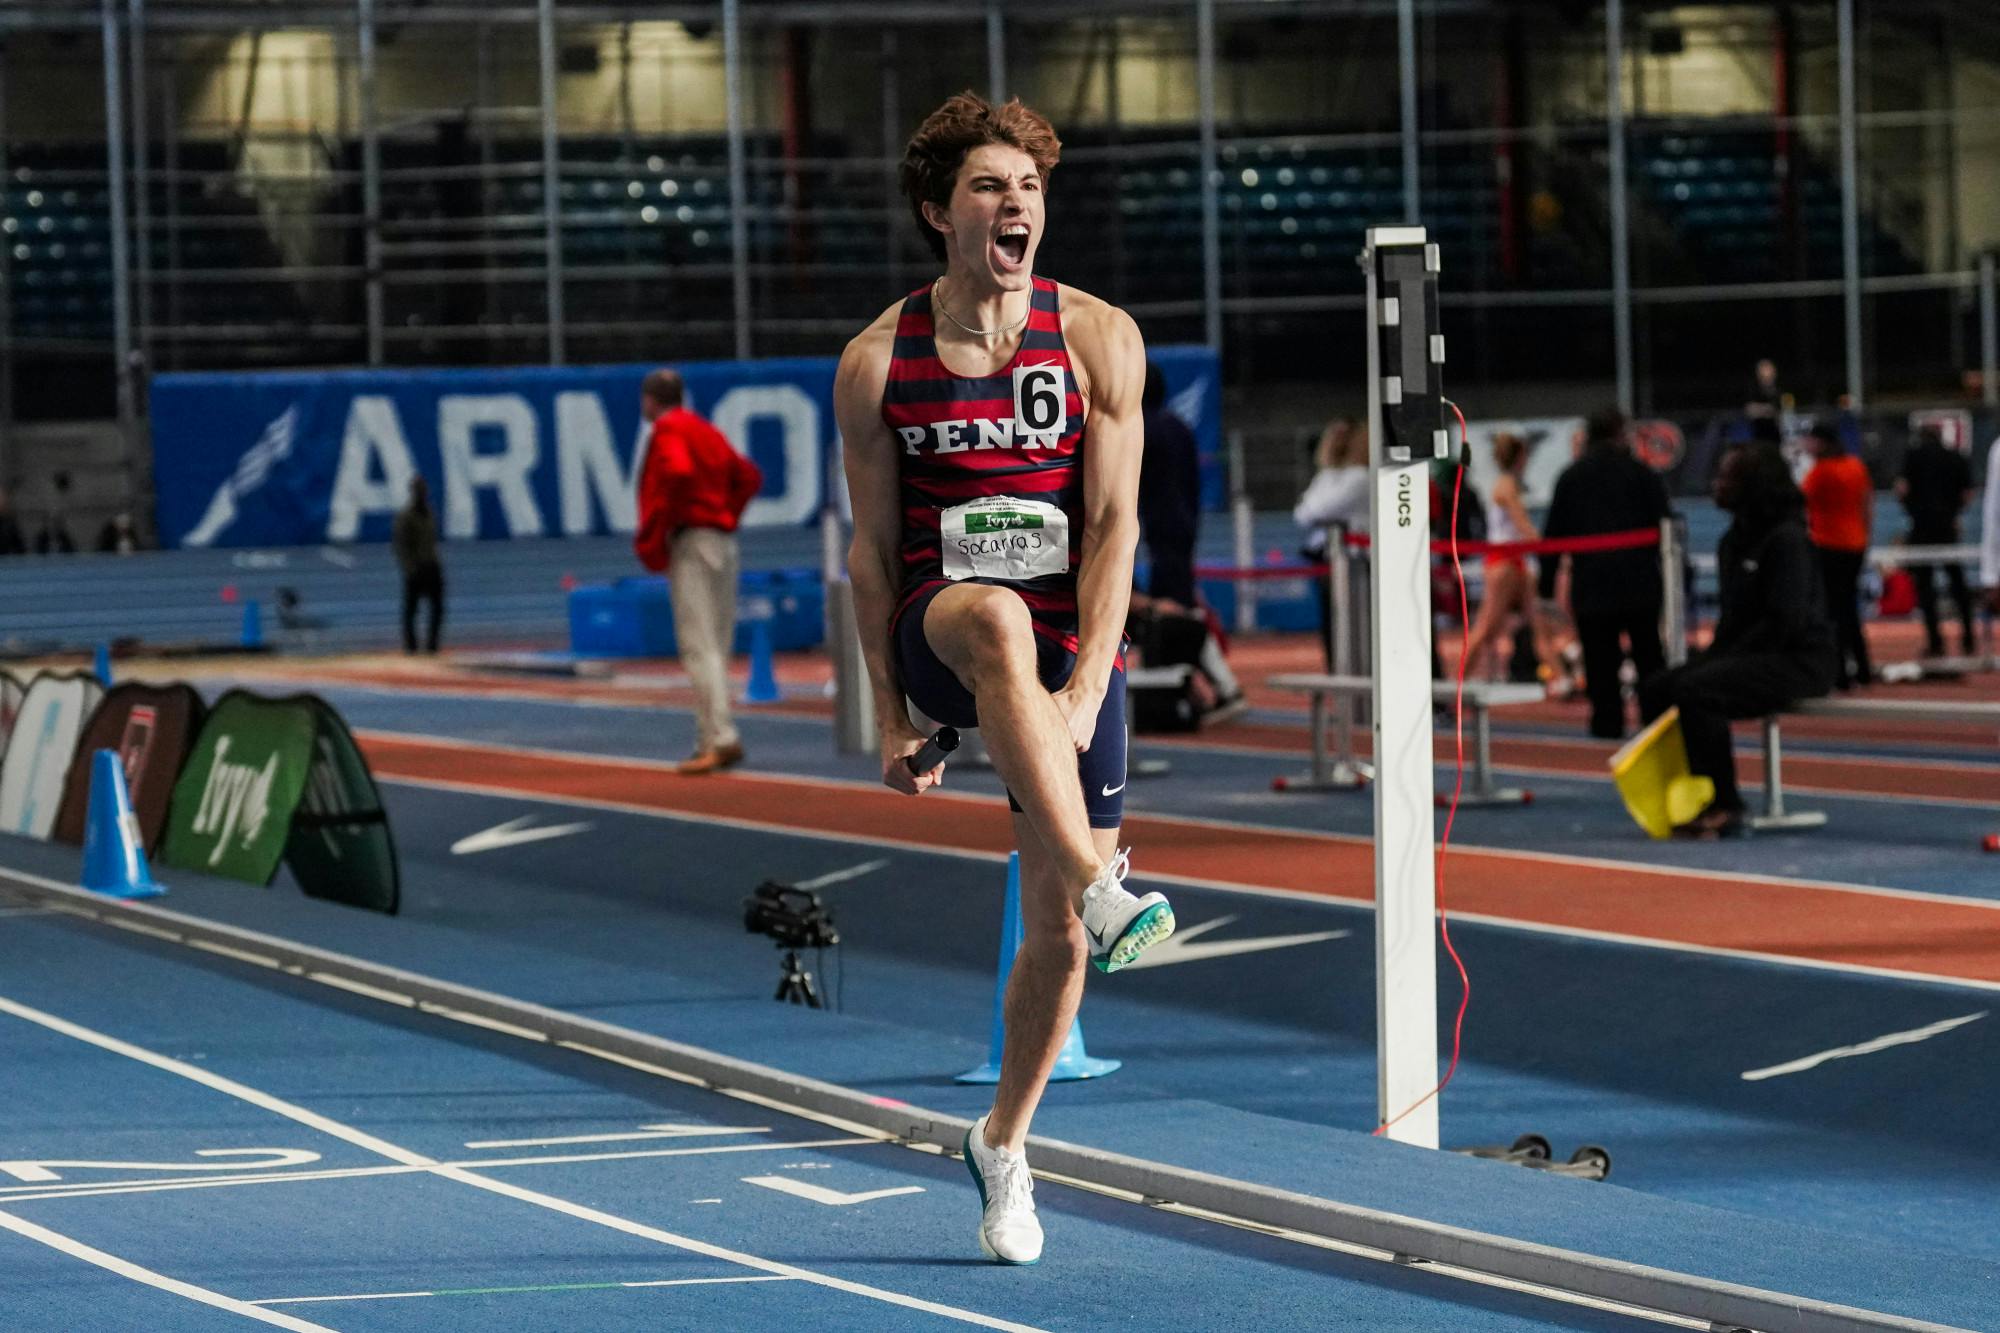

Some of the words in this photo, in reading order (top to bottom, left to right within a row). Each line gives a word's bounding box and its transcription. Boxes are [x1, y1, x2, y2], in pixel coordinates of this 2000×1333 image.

[1021, 371, 1060, 430] 6
[327, 384, 858, 539] ARMO
[1398, 490, 1411, 527] UCS
